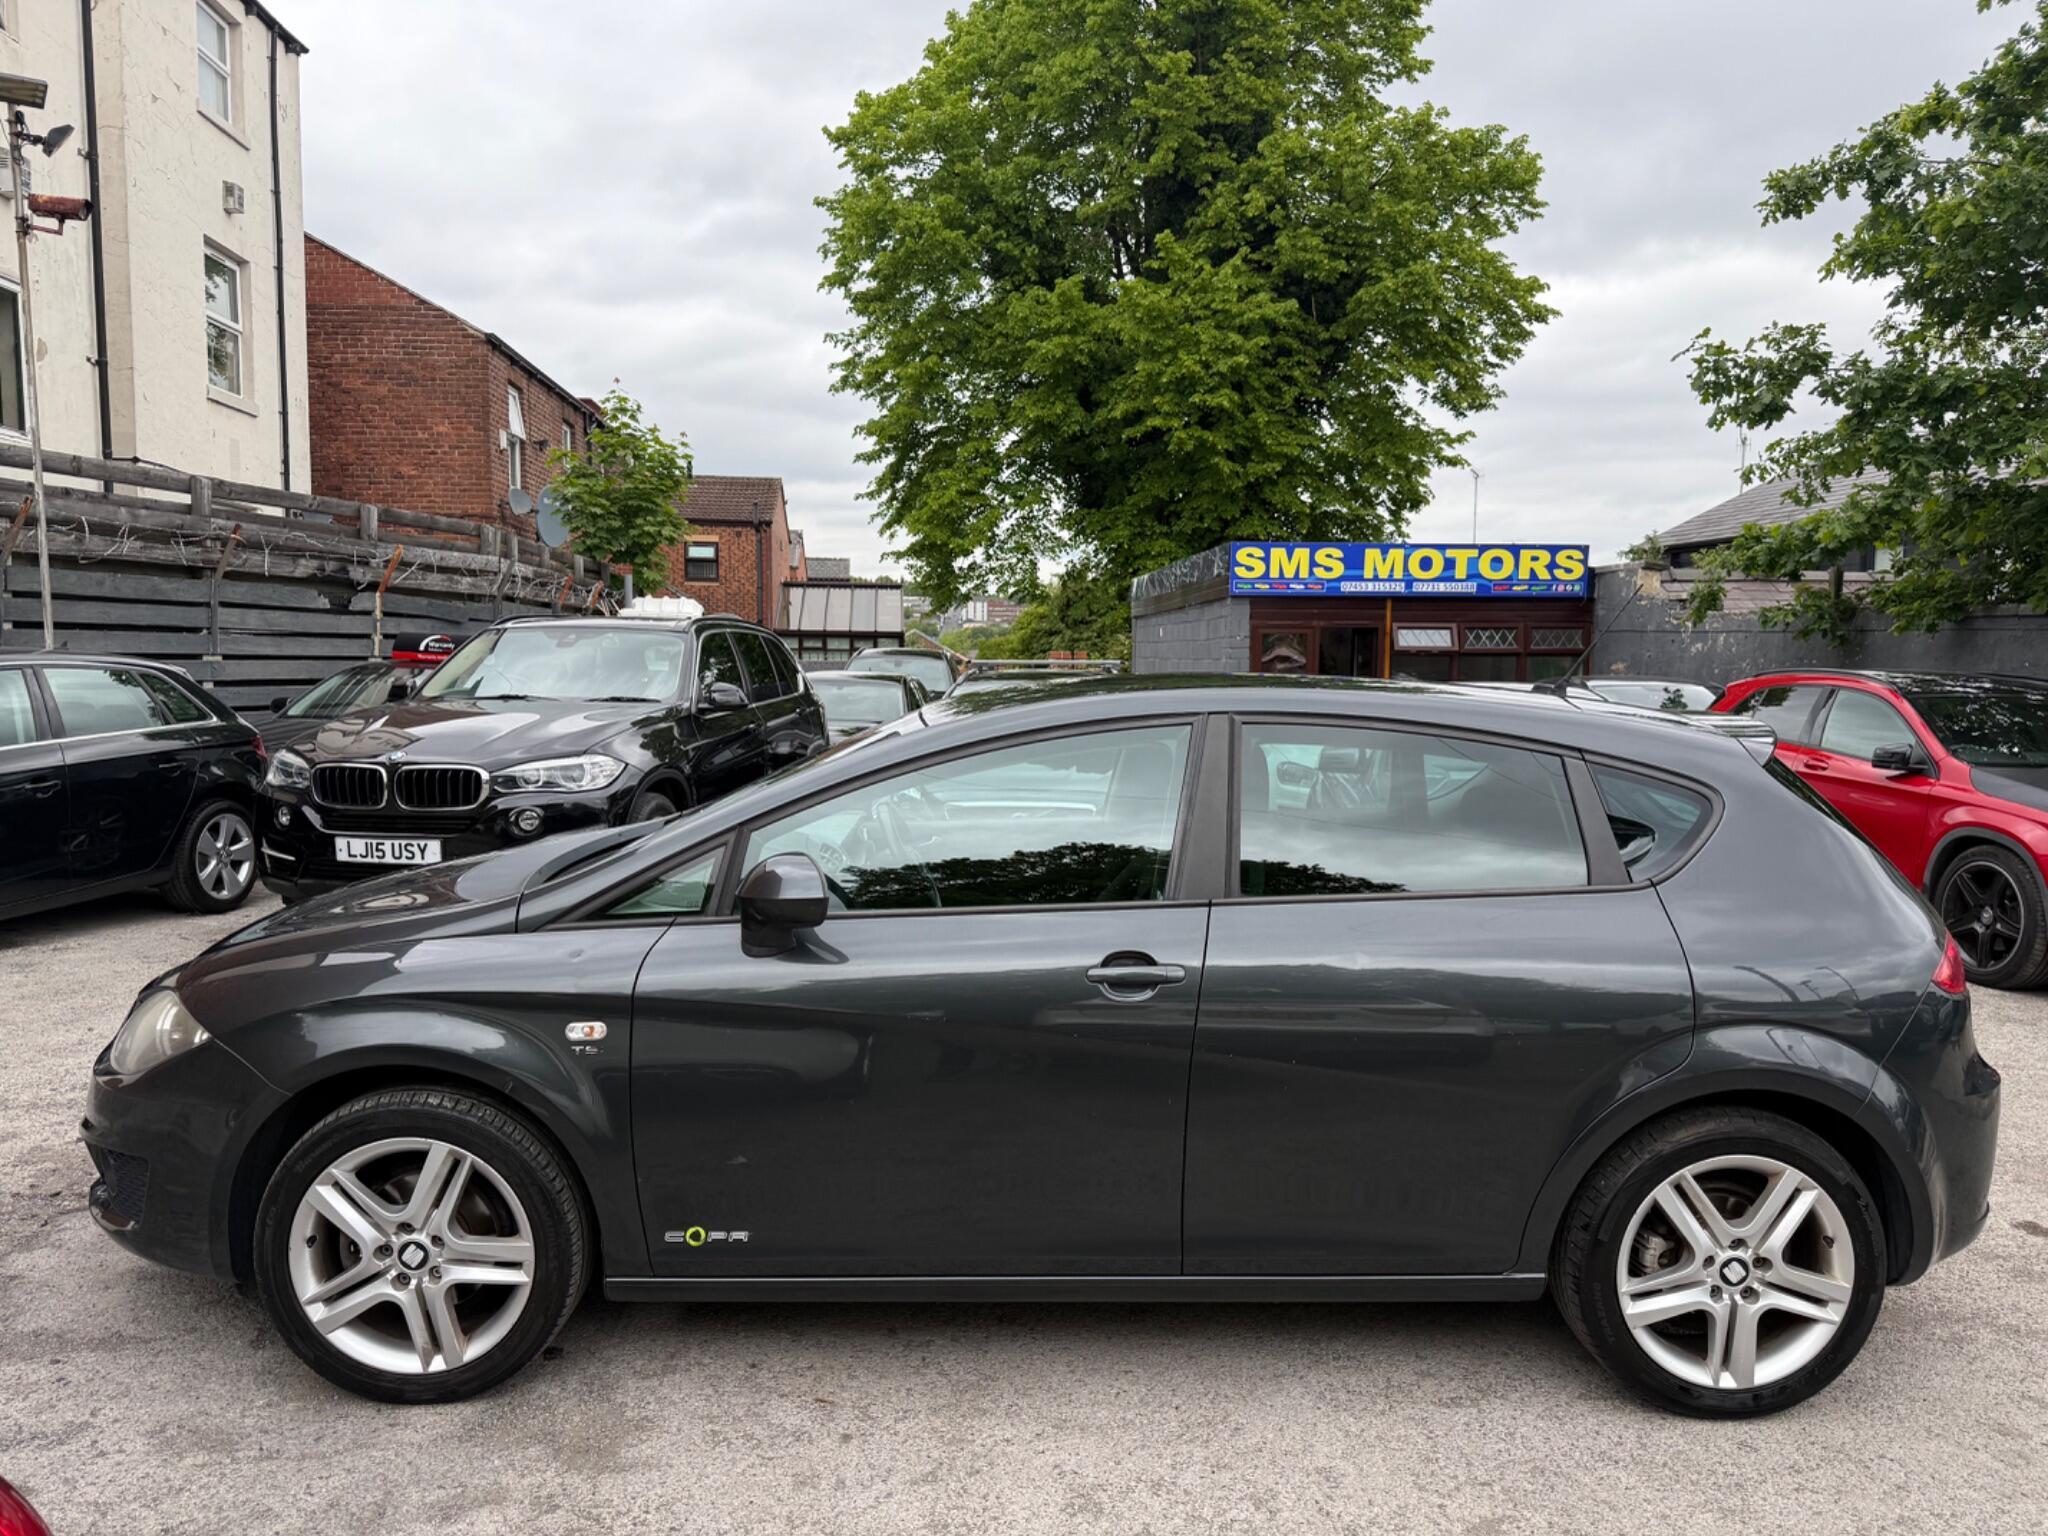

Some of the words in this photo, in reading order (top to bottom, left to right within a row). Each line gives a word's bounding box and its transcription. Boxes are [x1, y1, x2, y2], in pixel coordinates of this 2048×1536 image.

[1236, 548, 1344, 579] SMS
[1364, 548, 1585, 580] MOTORS
[347, 841, 385, 860] LJ15
[392, 842, 429, 861] USY
[664, 1226, 749, 1247] COPA
